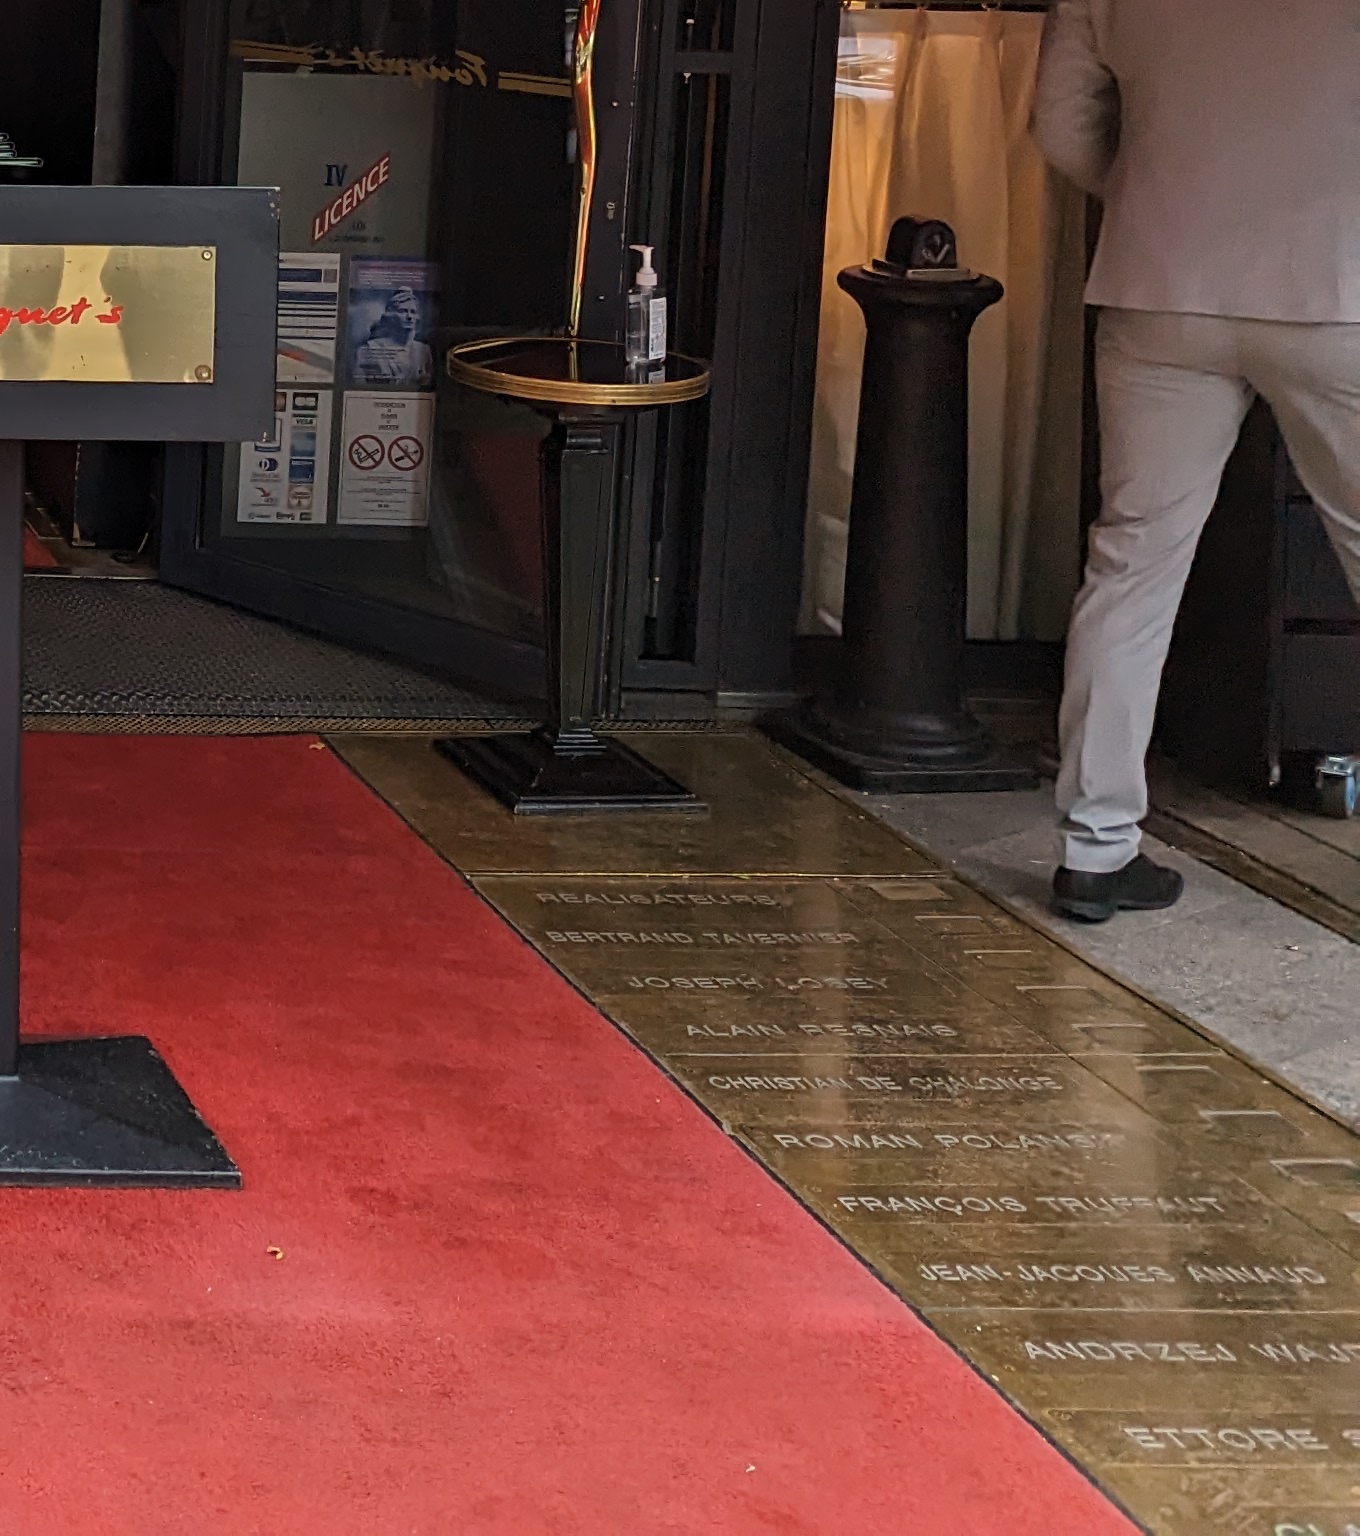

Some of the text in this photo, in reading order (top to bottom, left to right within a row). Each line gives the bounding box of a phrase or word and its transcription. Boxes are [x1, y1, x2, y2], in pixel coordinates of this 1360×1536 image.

[325, 164, 348, 187] IV
[314, 156, 390, 241] LICENCE
[545, 930, 859, 945] BERTRAND TAVERNIER
[628, 975, 763, 990] JOSEPH
[686, 1024, 959, 1038] ALAIN RESNAIS
[708, 1076, 1064, 1092] CHRISTIAN DE CHALONGE
[773, 1133, 1128, 1150] ROMAN POLANS
[837, 1196, 1028, 1216] FRANÇOIS
[920, 1264, 1327, 1285] JEAN-JACQUES ANNAUD
[1023, 1341, 1238, 1362] ANDRZEJ
[1122, 1426, 1329, 1452] ETTORE
